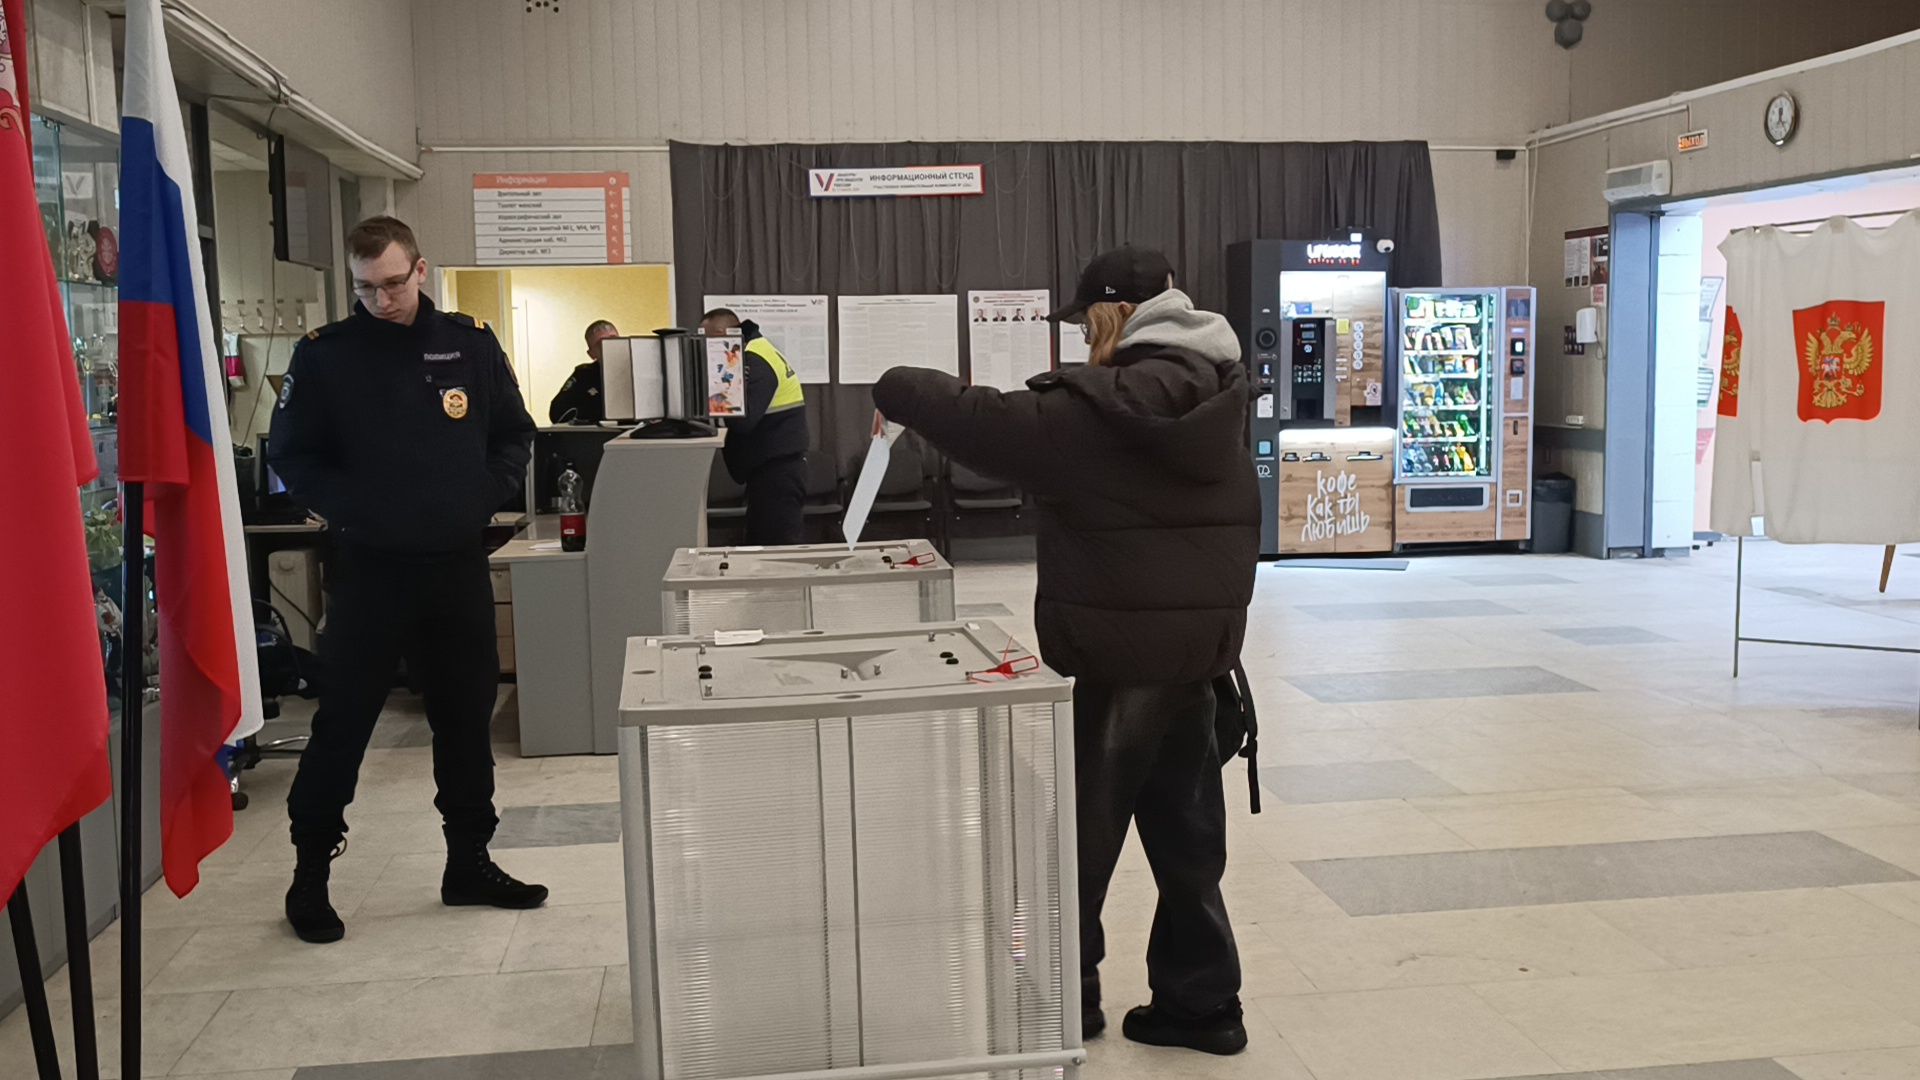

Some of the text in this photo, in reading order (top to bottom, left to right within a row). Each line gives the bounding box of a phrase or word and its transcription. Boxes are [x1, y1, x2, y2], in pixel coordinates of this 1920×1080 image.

[1679, 134, 1704, 149] ВЫХОД
[497, 176, 547, 185] Информация
[869, 171, 974, 182] ИНФОРМАЦИОННЫЙ СТЕНД
[423, 351, 461, 361] ПОЛИЦИЯ
